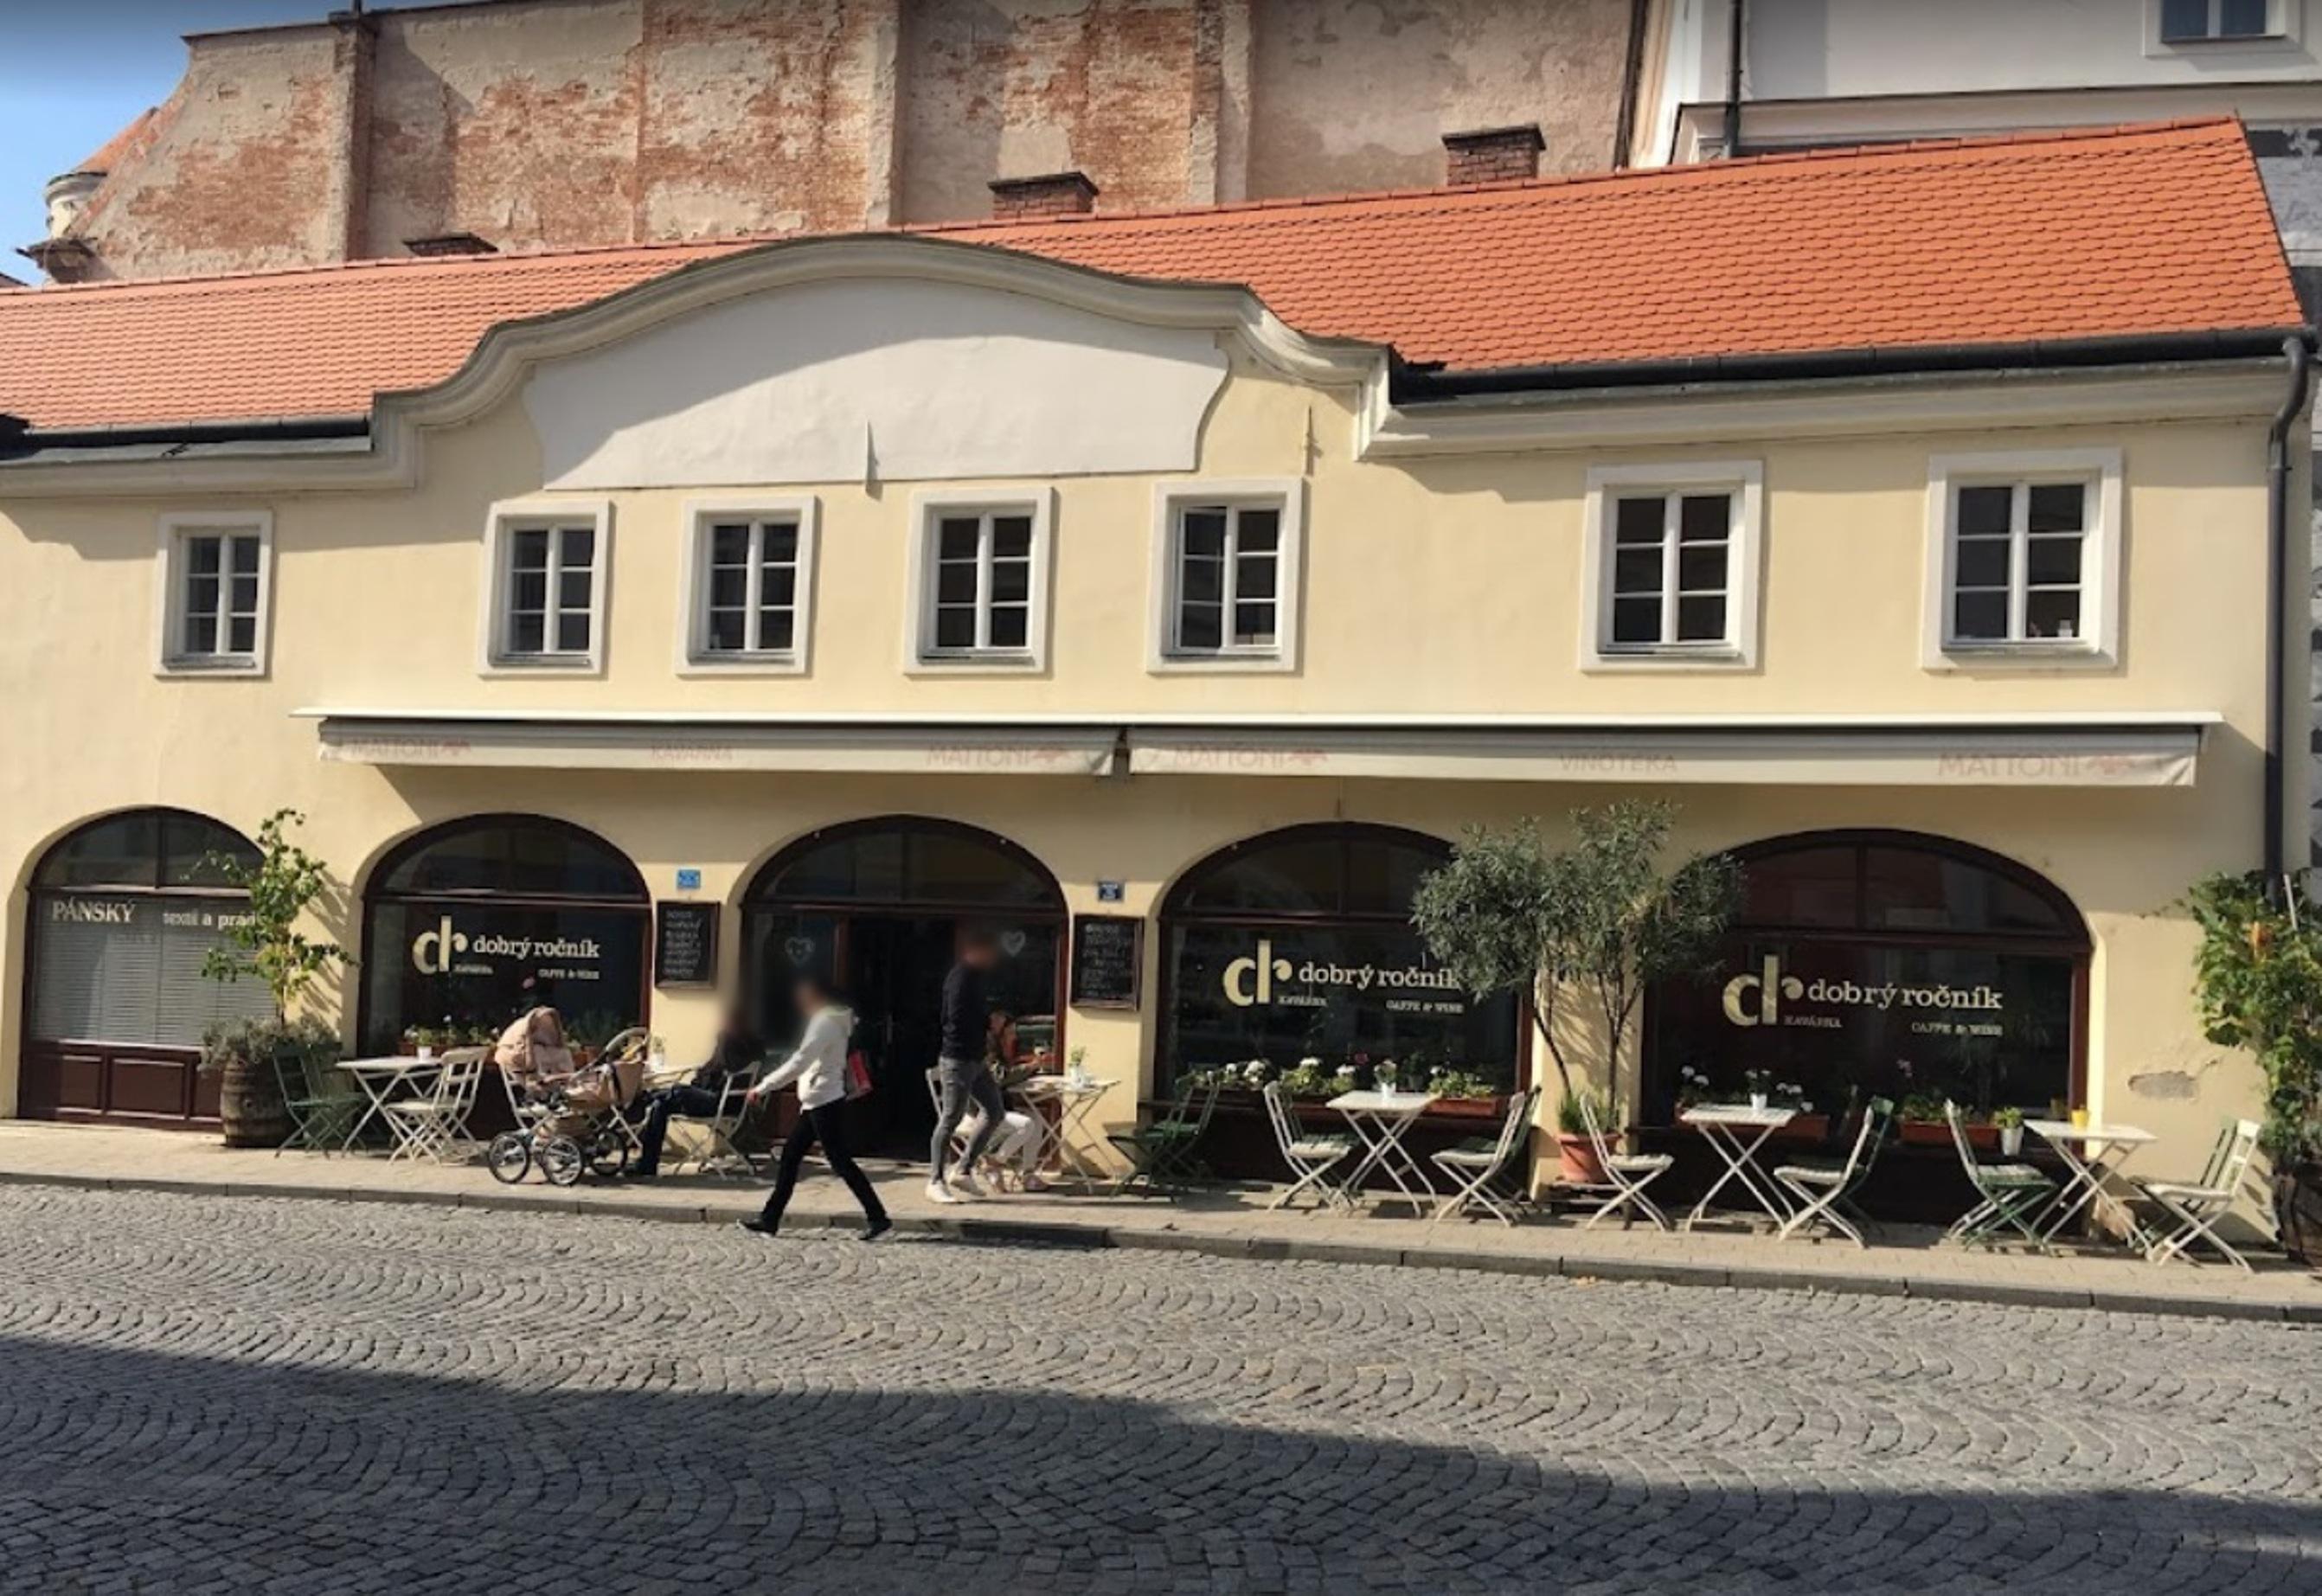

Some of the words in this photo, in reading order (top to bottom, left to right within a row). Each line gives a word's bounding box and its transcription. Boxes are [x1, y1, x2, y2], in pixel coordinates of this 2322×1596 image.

[926, 744, 1030, 766] MATTONI
[1174, 745, 1284, 767] MATTONI
[1559, 753, 1677, 772] VINOTEKA
[1938, 752, 2078, 777] MATTONI
[53, 896, 136, 923] PÁNSKÝ
[202, 913, 212, 926] a
[473, 934, 530, 960] dobrý
[534, 938, 600, 958] ročník
[1299, 961, 1375, 990] dobrý
[1377, 966, 1462, 990] ročník
[1808, 978, 1897, 1010] dobrý
[1902, 984, 2004, 1010] ročník
